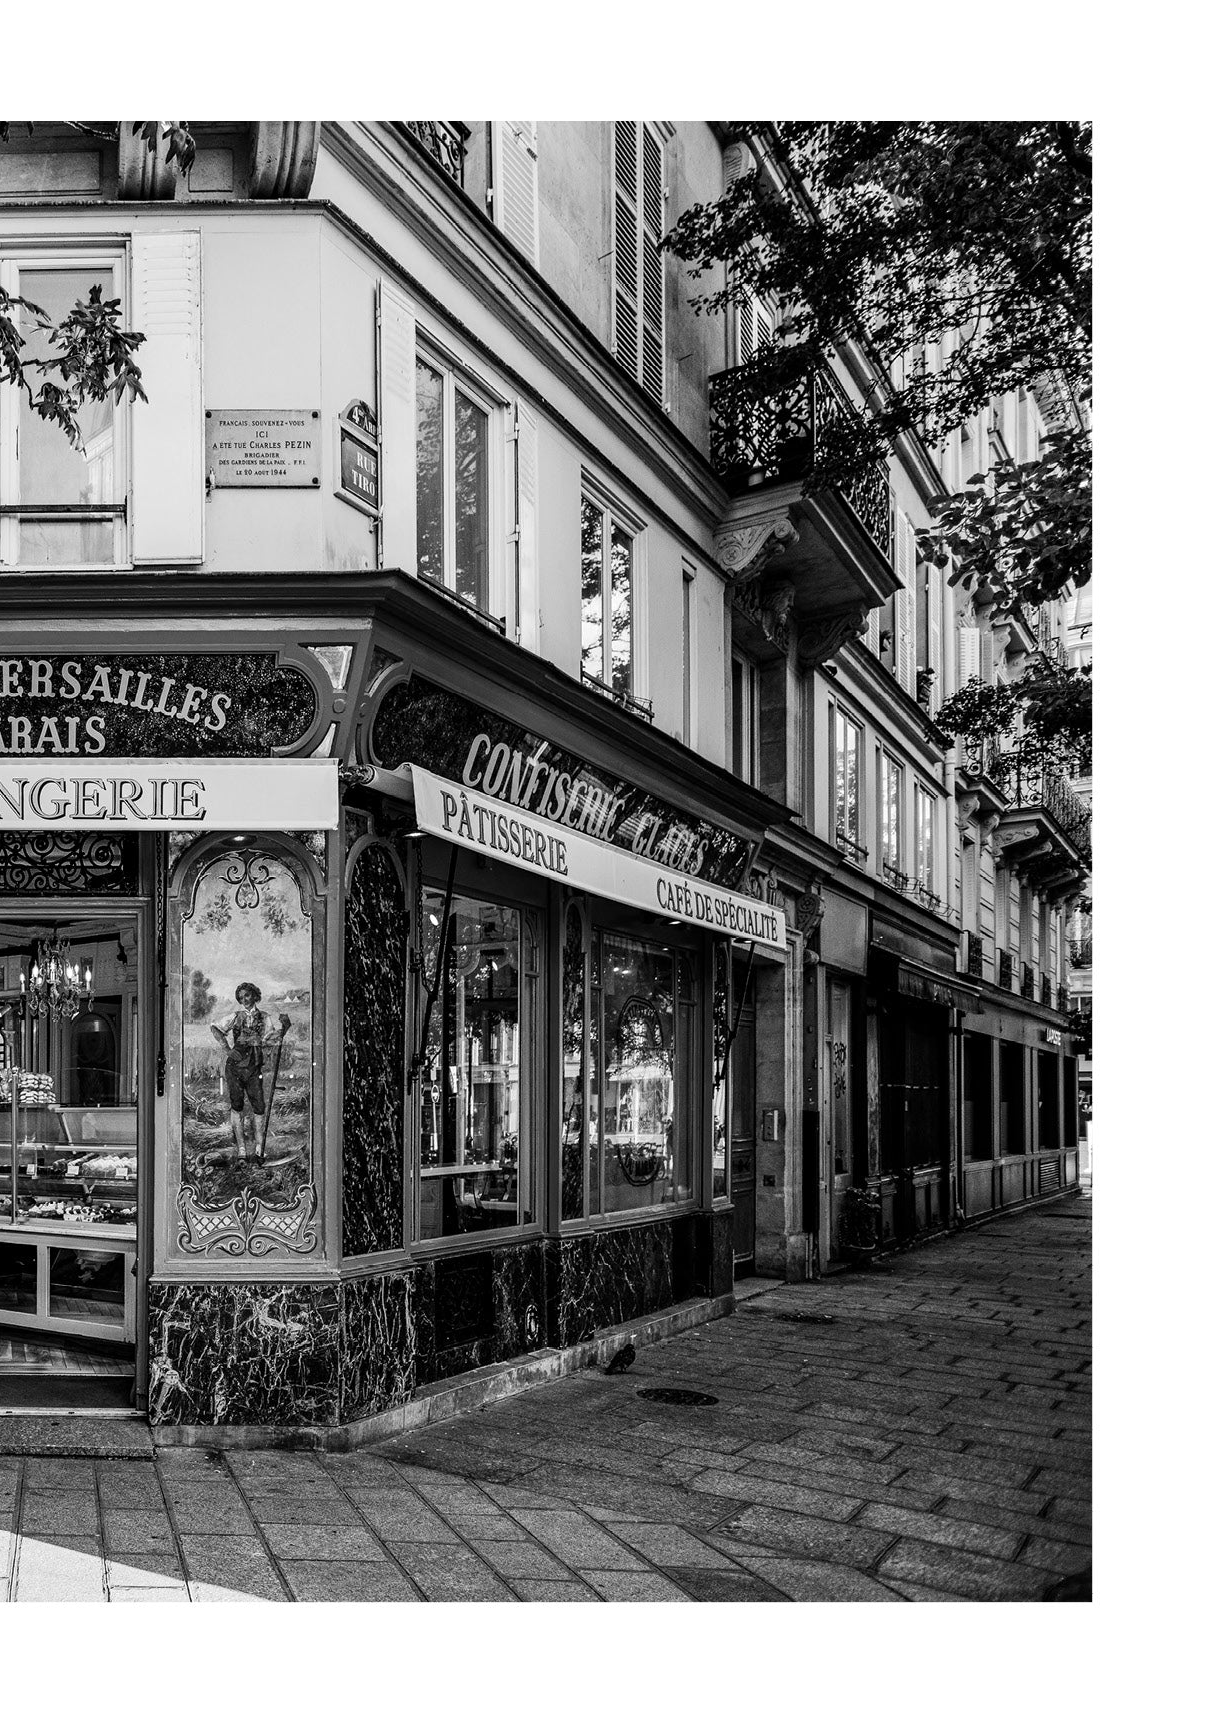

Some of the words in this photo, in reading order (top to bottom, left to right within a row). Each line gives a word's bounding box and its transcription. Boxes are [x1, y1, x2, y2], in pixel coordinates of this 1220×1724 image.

[285, 441, 312, 449] PEZIN
[356, 451, 377, 478] RUE
[440, 790, 568, 876] PÂTISSERIE
[462, 733, 626, 842] CONFISERIE
[632, 812, 709, 875] GLACES
[656, 877, 693, 918] CAFÉ
[694, 891, 714, 923] DE
[715, 897, 778, 942] SPÉCIALITÉ
